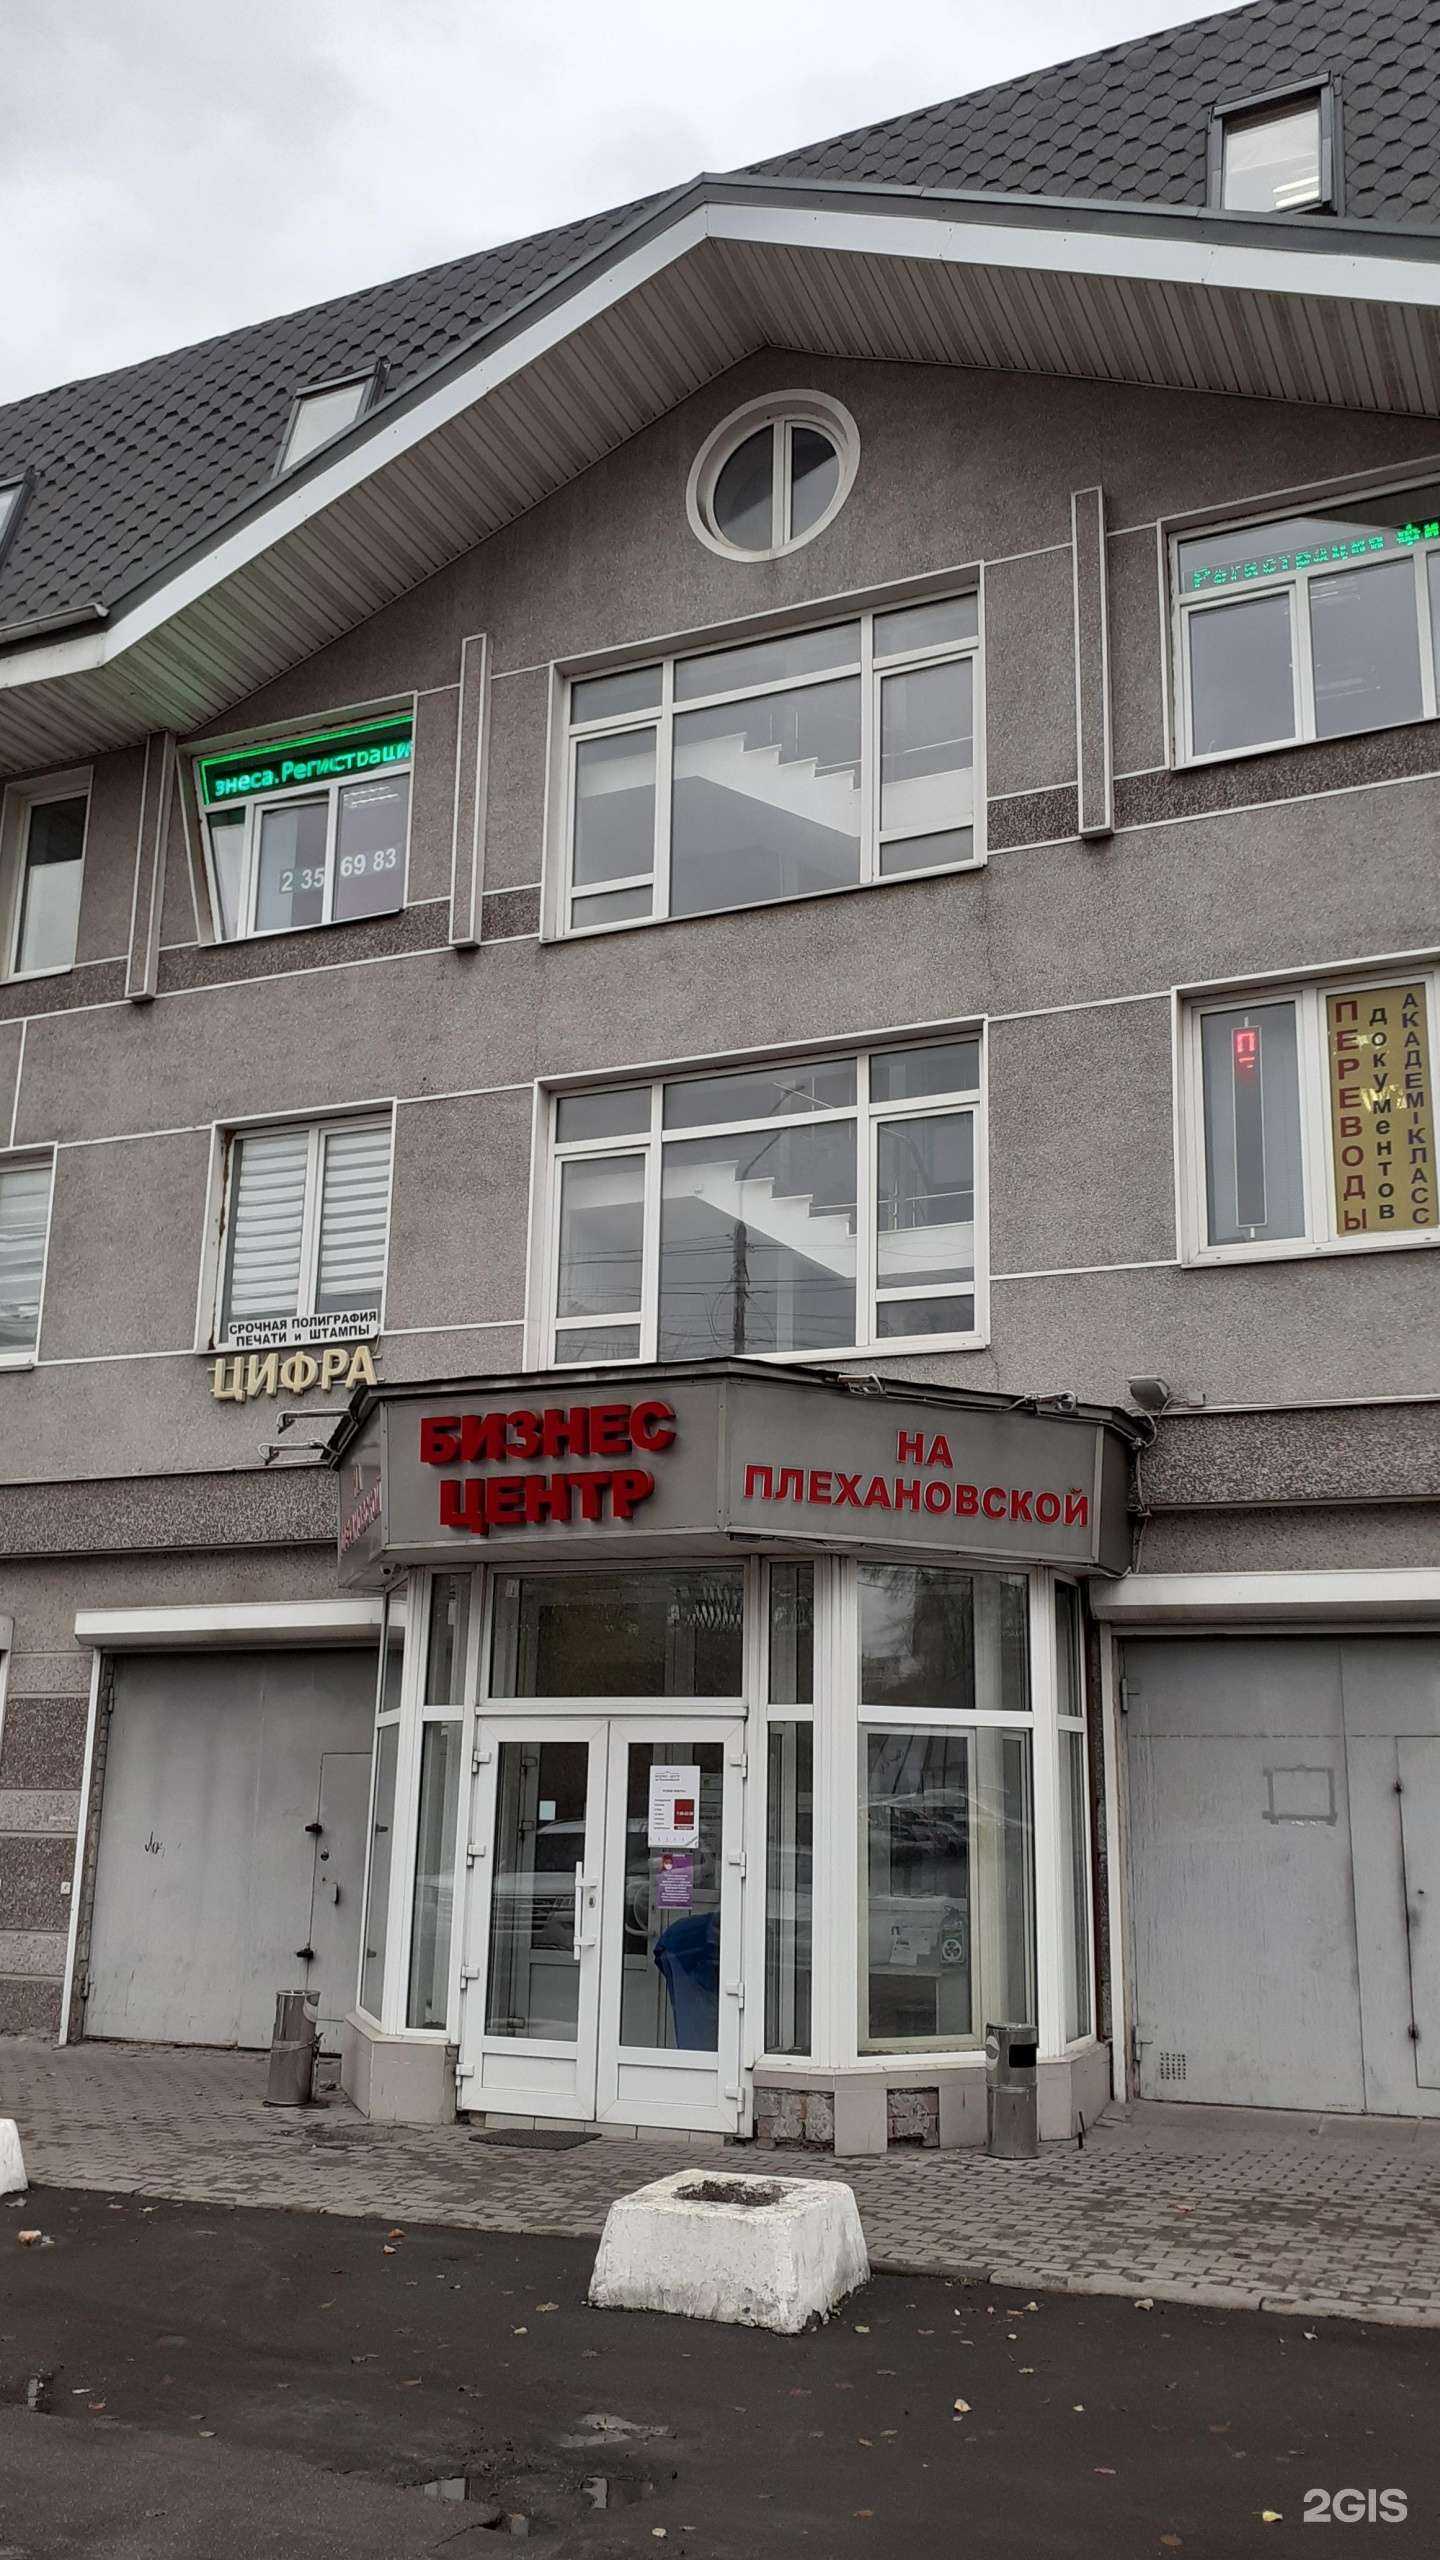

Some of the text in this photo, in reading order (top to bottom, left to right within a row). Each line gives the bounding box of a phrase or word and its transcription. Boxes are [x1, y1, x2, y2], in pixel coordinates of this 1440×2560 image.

[280, 847, 398, 893] 2 35 69 83
[1335, 1000, 1368, 1231] ПЕРЕВОДЫ
[229, 1311, 377, 1335] СРОЧНАЯ ПОЛИГРАФИЯ
[236, 1331, 287, 1347] ПЕЧАТИ
[309, 1324, 370, 1340] ШТАМПЫ
[213, 1346, 378, 1402] ЦИФРА
[420, 1401, 677, 1465] БИЗНЕС
[896, 1429, 954, 1468] НА
[440, 1469, 655, 1536] ЦЕНТР
[743, 1464, 1090, 1527] ПЛЕХАНОВСКОЙ
